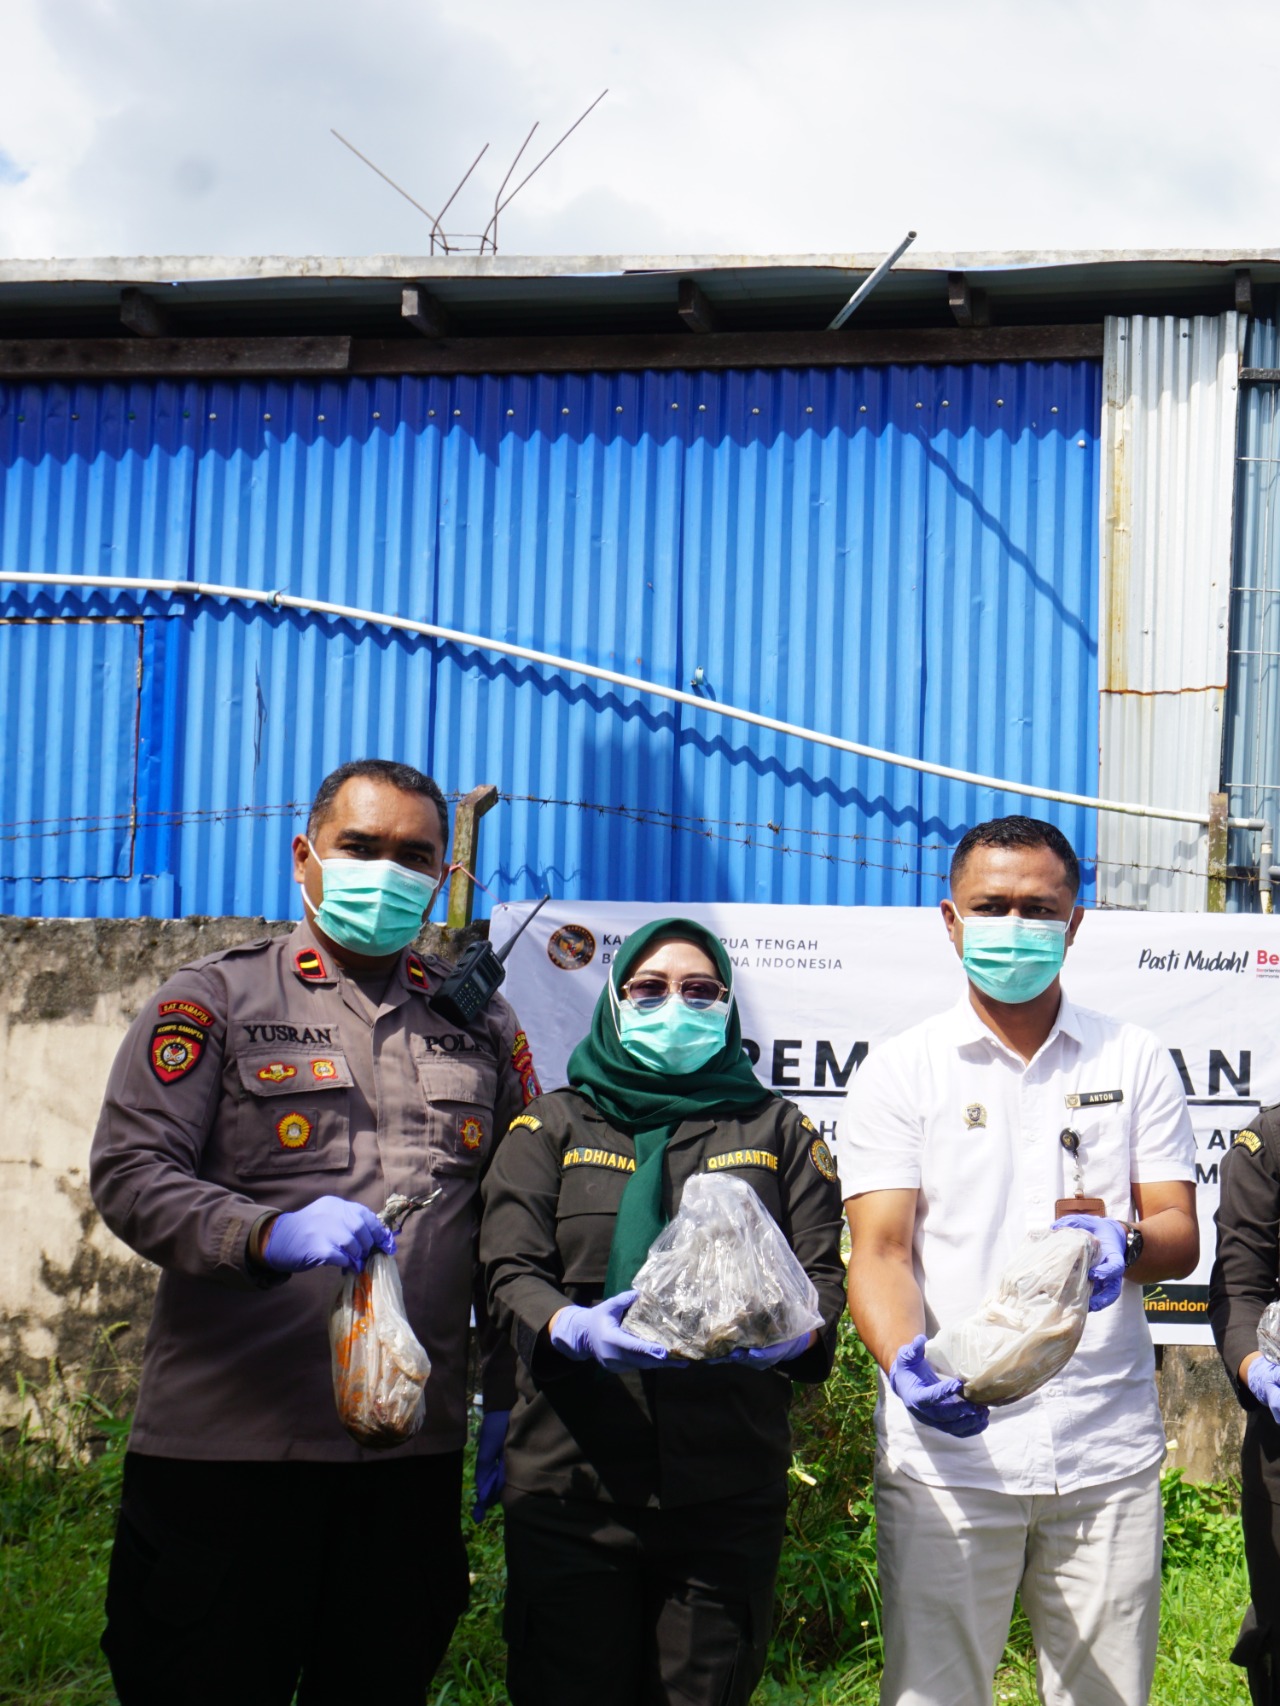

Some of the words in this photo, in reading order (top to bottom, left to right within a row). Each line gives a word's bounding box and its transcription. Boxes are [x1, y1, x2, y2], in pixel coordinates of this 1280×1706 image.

[720, 938, 749, 949] PUA
[756, 939, 818, 951] TENGAH
[756, 957, 843, 970] INDONESIA
[1138, 948, 1180, 972] Pasti
[1184, 950, 1249, 973] Mudah!
[163, 1003, 177, 1012] SAT
[178, 1003, 209, 1023] SAMAPTA
[178, 1025, 204, 1040] SAMAPTA
[243, 1024, 332, 1044] YUSRAN
[1089, 1092, 1114, 1103] ANTON
[584, 1148, 636, 1172] DHIANA
[708, 1150, 779, 1170] QUARANTINE
